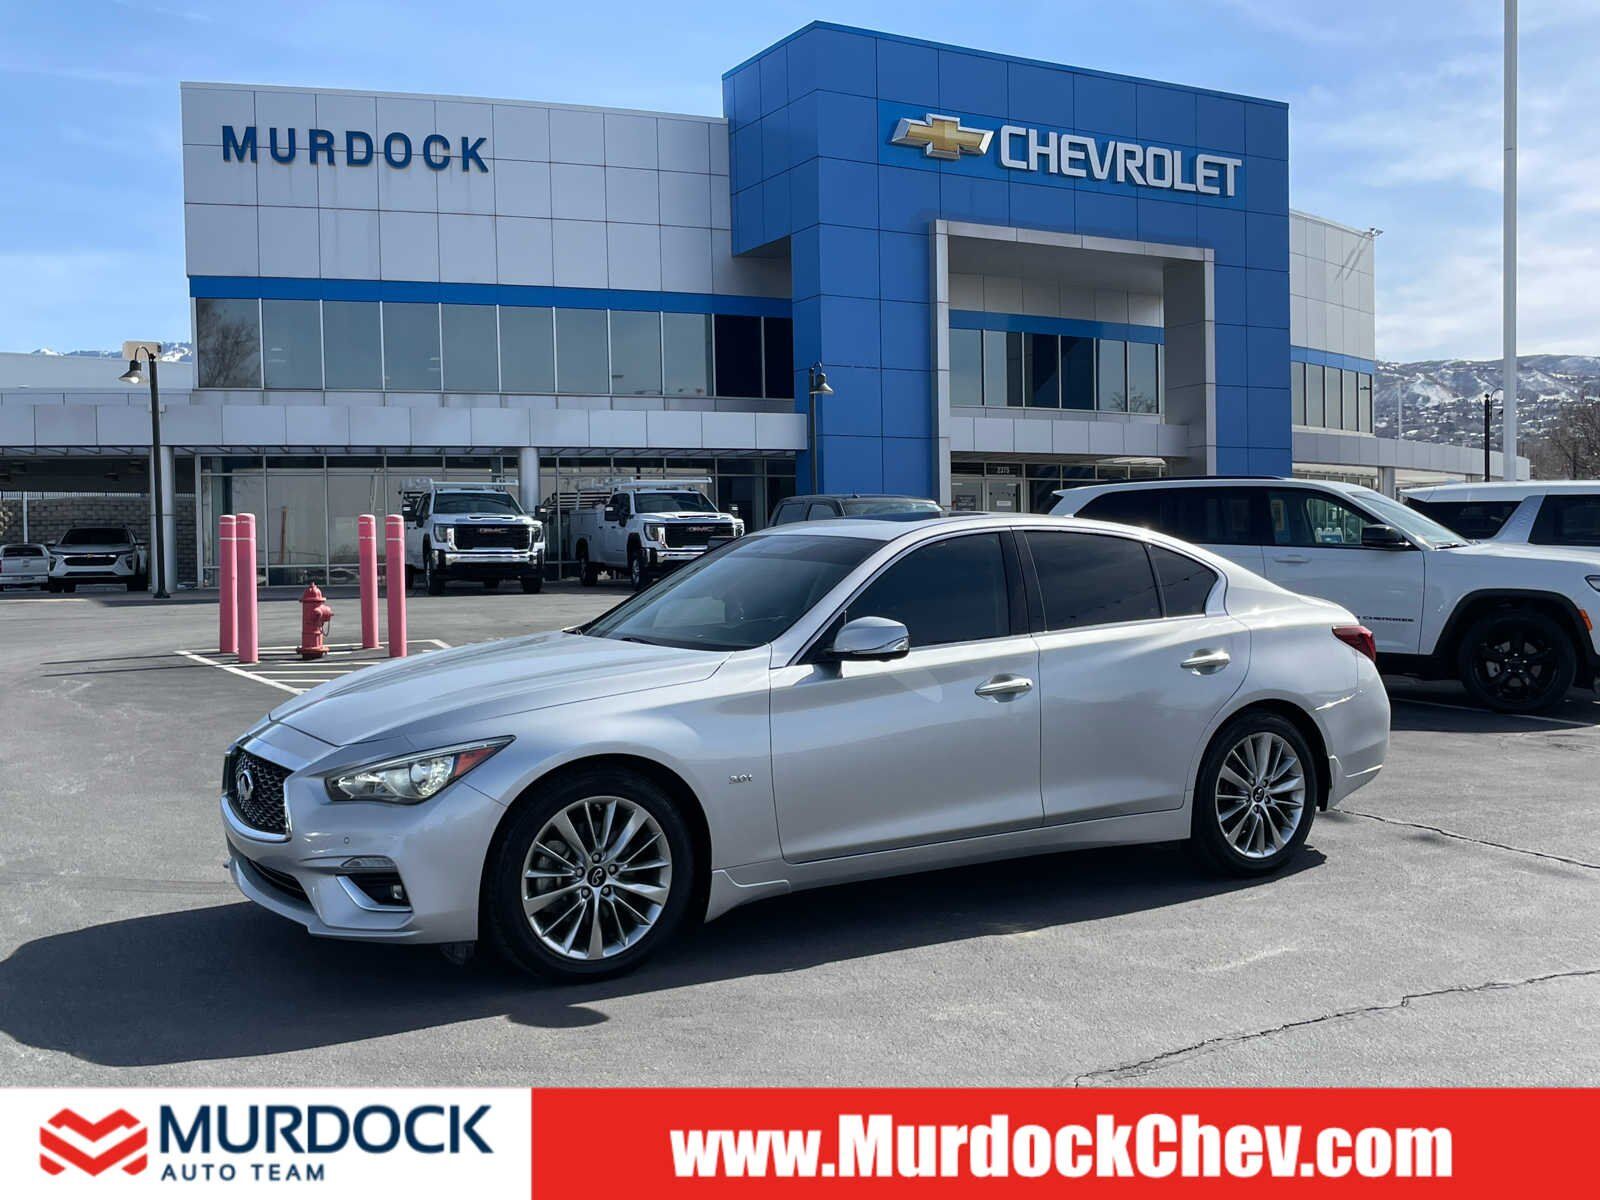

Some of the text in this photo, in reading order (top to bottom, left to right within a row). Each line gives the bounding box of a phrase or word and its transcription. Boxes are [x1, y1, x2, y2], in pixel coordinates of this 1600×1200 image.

[222, 124, 490, 173] MURDOCK
[1000, 124, 1243, 197] CHEVROLET
[479, 527, 509, 535] GMC
